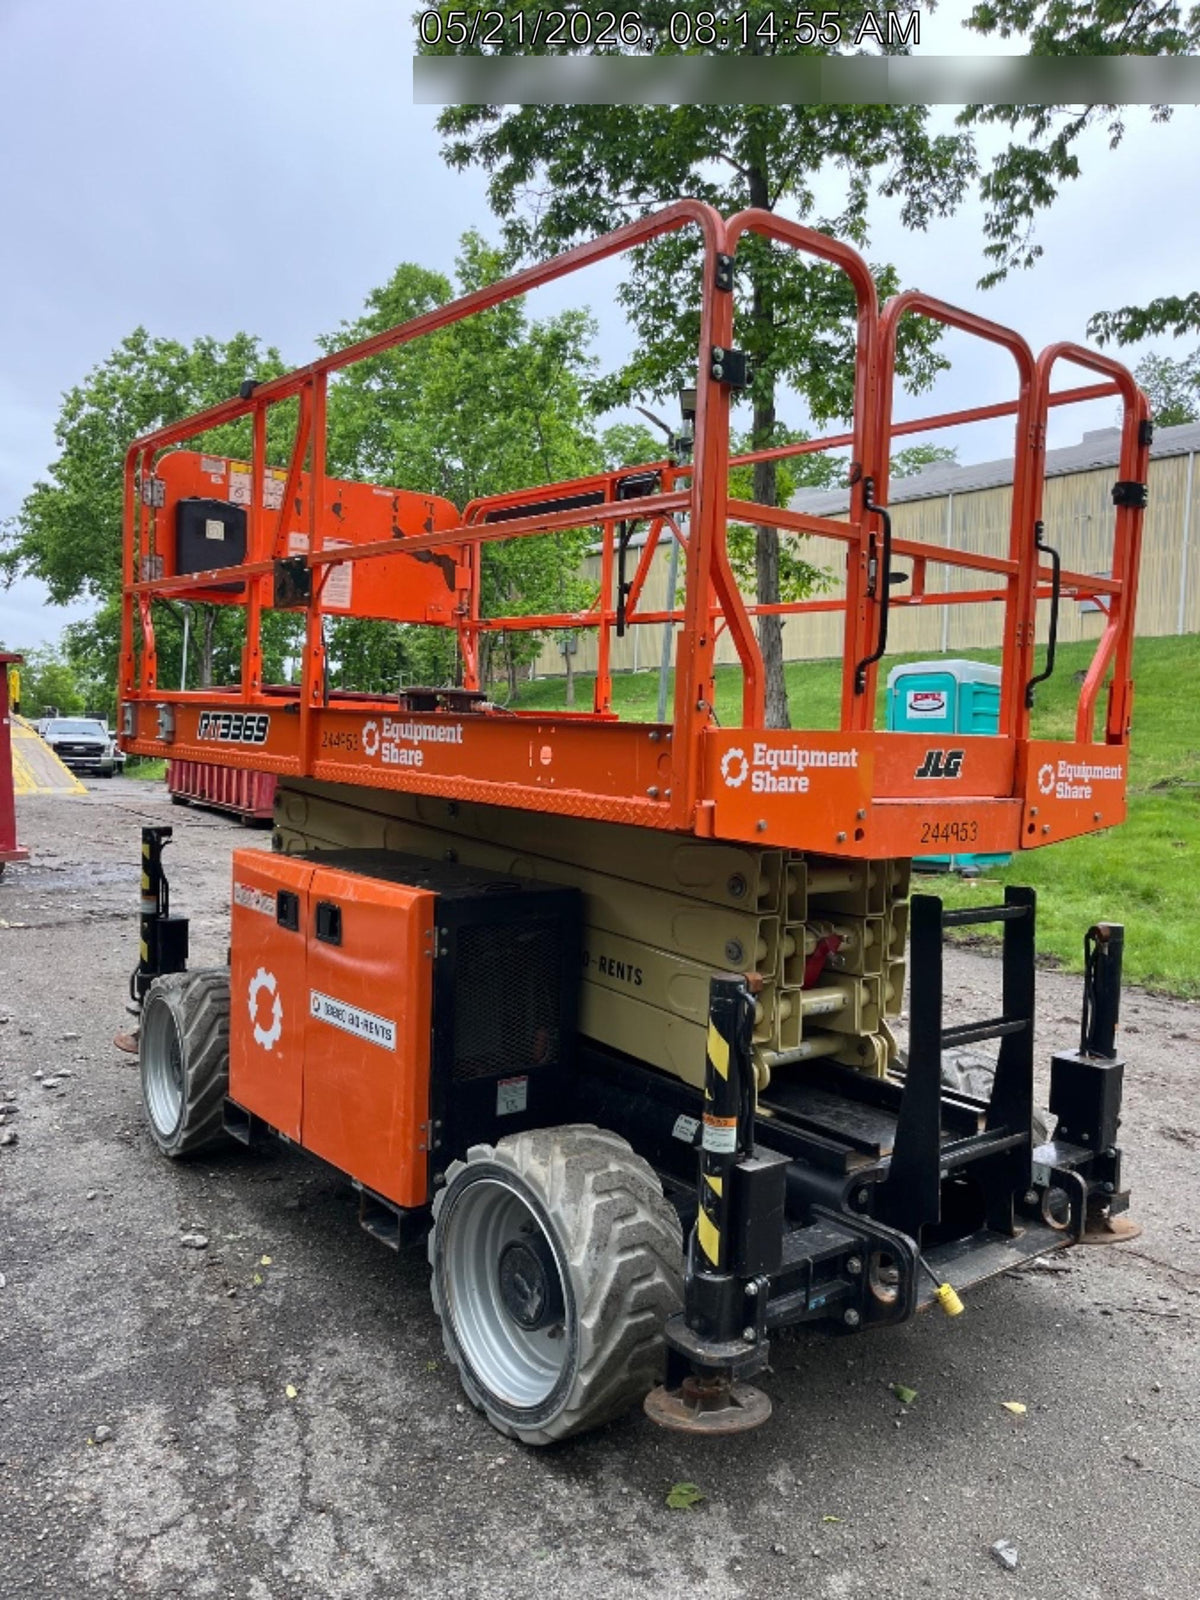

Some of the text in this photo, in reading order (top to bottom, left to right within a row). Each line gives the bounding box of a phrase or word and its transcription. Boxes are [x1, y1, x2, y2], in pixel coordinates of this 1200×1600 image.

[382, 717, 463, 746] Equipment
[381, 742, 423, 767] Share
[752, 742, 859, 771] Equipment
[914, 750, 964, 780] JLG
[751, 770, 810, 793] Share
[1057, 760, 1123, 783] Equipment
[1055, 782, 1092, 799] Share
[920, 820, 978, 844] 244953
[582, 950, 643, 986] 0-RENTS
